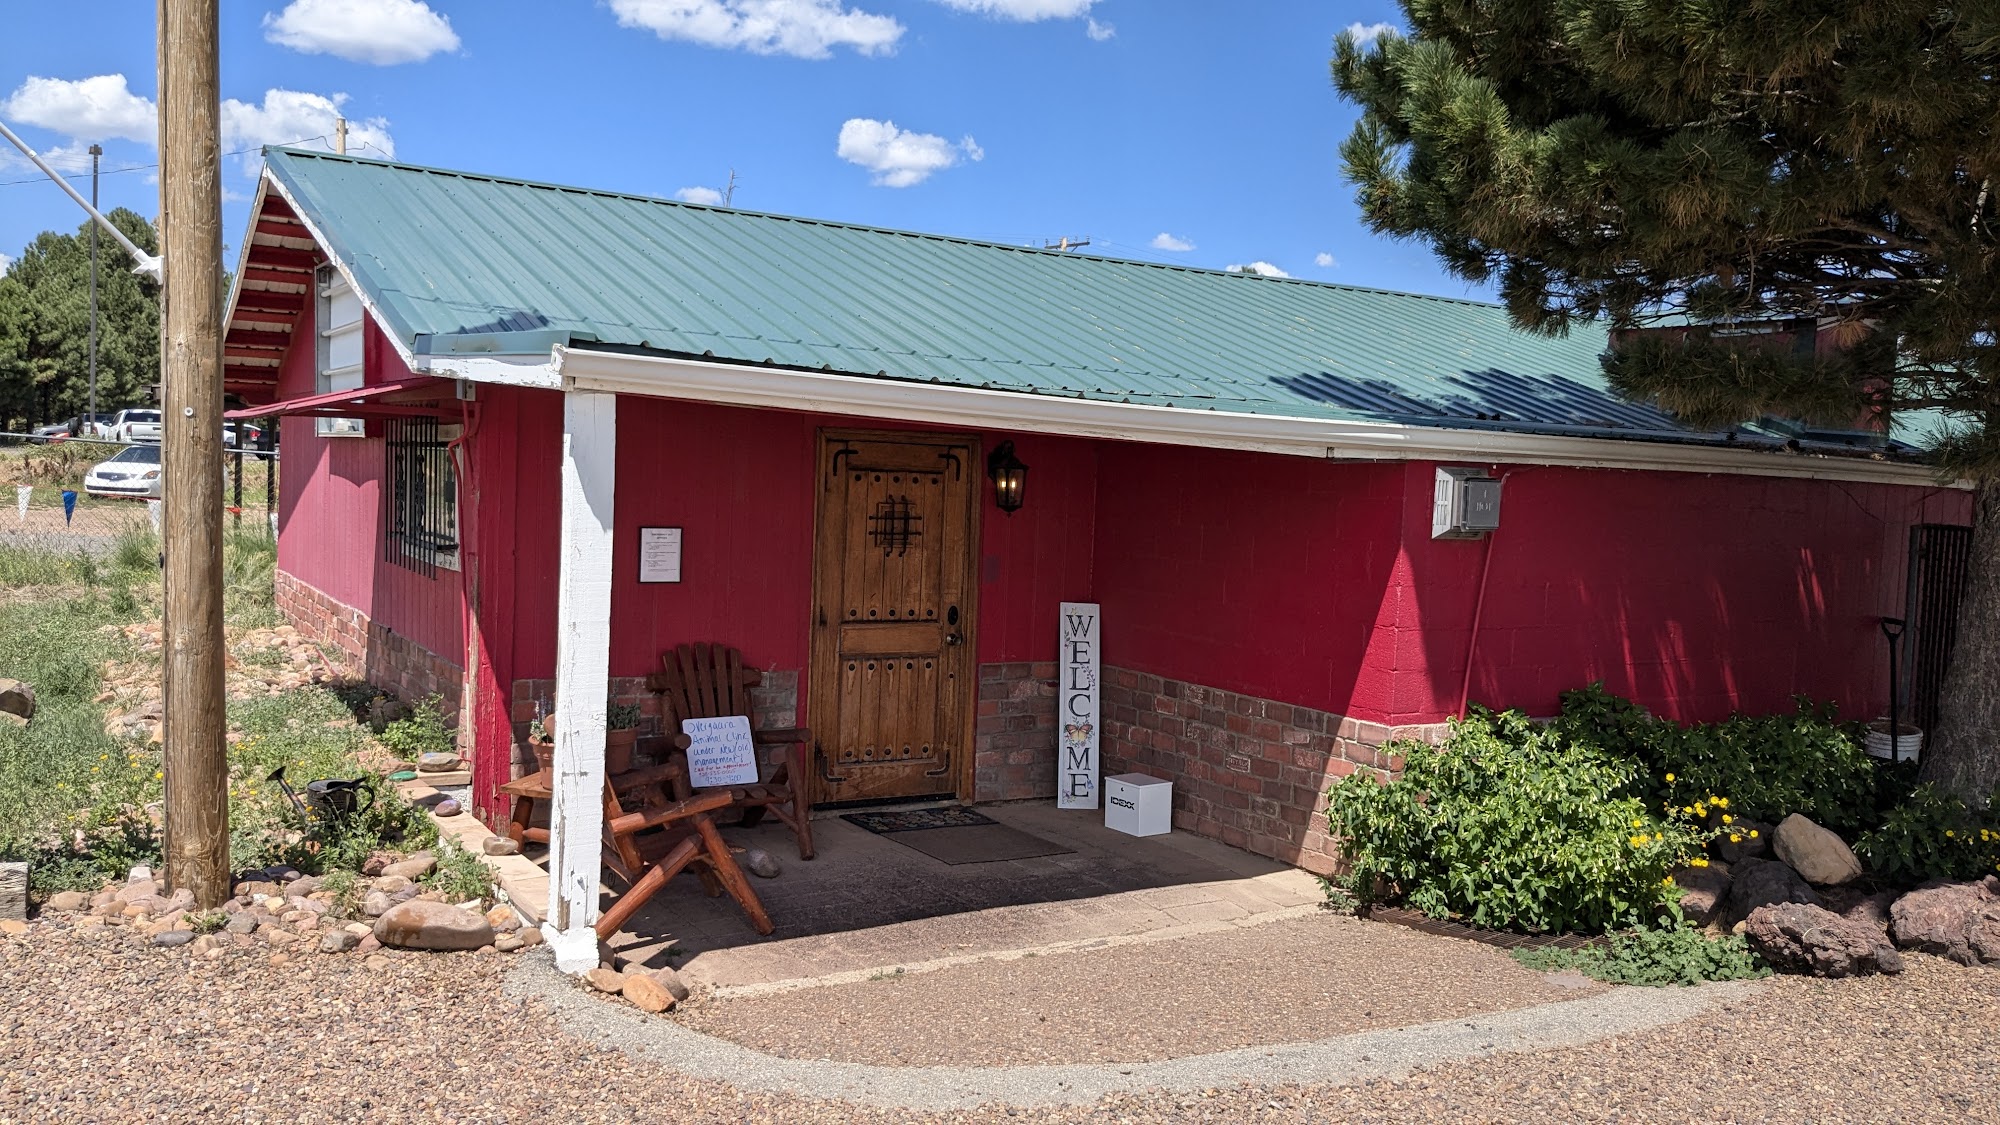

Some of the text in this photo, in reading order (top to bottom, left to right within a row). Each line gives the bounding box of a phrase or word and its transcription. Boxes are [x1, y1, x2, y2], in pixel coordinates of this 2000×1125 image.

[1066, 615, 1094, 798] WELCME
[692, 734, 721, 745] Animal
[1110, 796, 1135, 810] IDEXX
